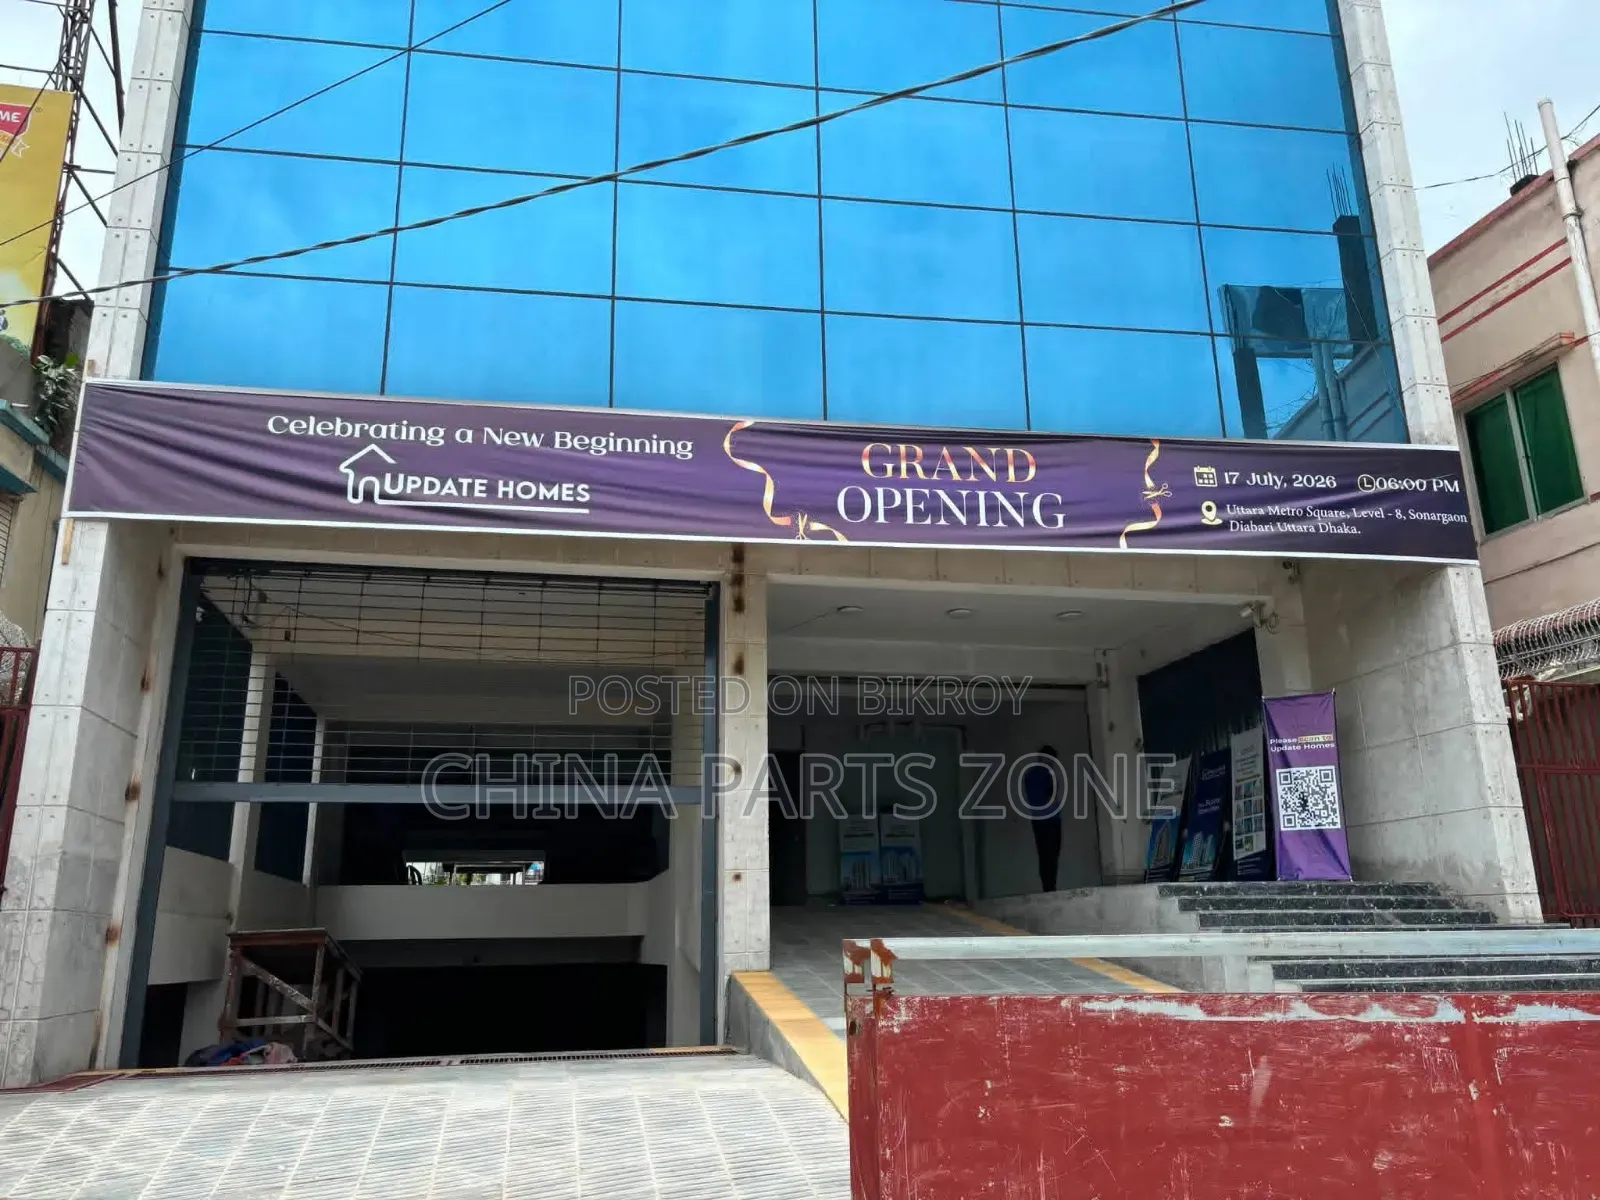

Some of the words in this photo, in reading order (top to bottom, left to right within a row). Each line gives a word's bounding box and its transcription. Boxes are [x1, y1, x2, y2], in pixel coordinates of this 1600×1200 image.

[267, 415, 446, 446] Celebrating
[454, 428, 473, 444] a
[483, 427, 544, 448] New
[554, 431, 693, 460] Beginning
[861, 442, 1037, 483] GRAND
[384, 473, 488, 498] UPDATE
[498, 480, 591, 502] HOMES
[1224, 472, 1240, 485] 17
[1246, 472, 1287, 490] July,
[1291, 474, 1337, 488] 2026
[1375, 477, 1427, 492] 06:00
[1433, 479, 1460, 493] PM
[836, 485, 1066, 529] OPENING
[1226, 504, 1264, 516] Uttara
[1267, 505, 1303, 517] Metro
[1306, 506, 1350, 521] Square,
[1352, 507, 1385, 518] Level
[1395, 509, 1406, 520] 8,
[1408, 510, 1468, 525] Sonargaon
[1229, 521, 1274, 532] Diabari
[1276, 522, 1316, 533] Uttara
[1318, 523, 1361, 535] Dhaka.
